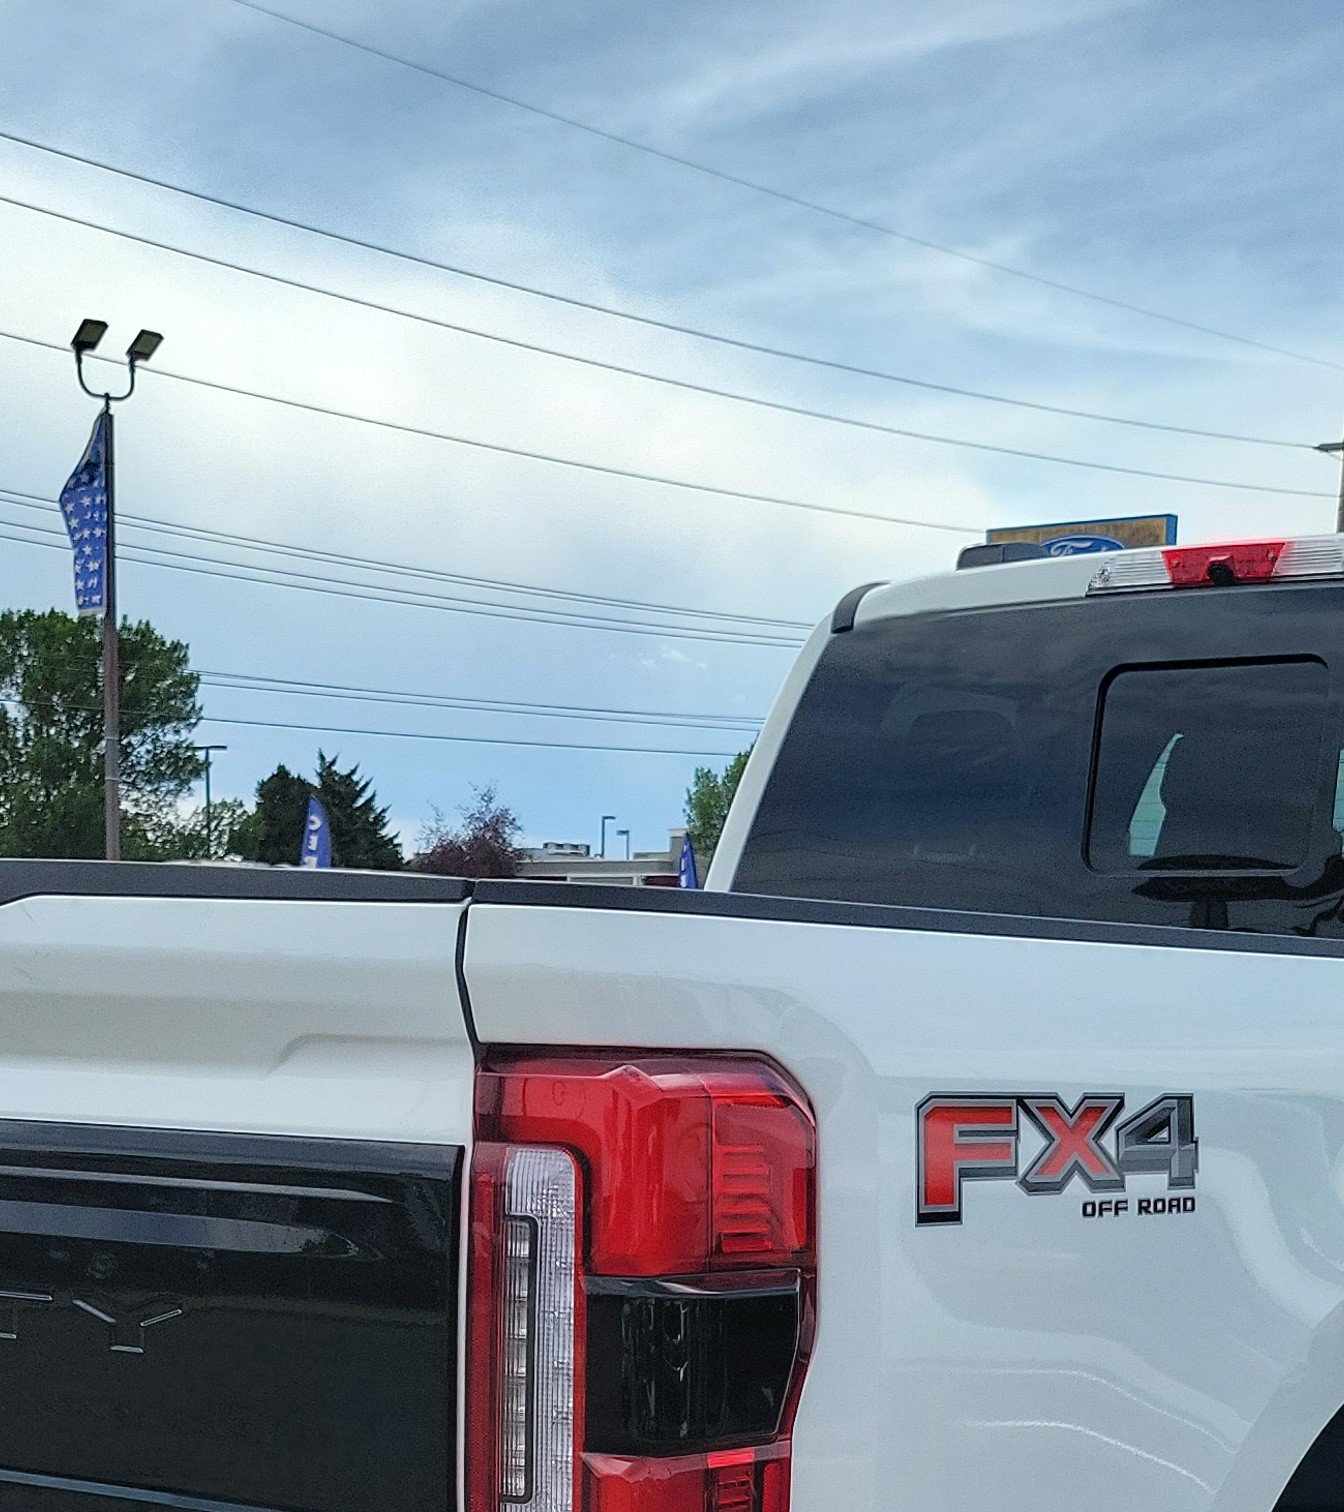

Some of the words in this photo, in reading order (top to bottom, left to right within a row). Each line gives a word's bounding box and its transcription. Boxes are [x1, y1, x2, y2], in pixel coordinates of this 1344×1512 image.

[915, 1091, 1199, 1228] FX4
[1082, 1199, 1128, 1218] OFF
[1138, 1196, 1196, 1217] ROAD
